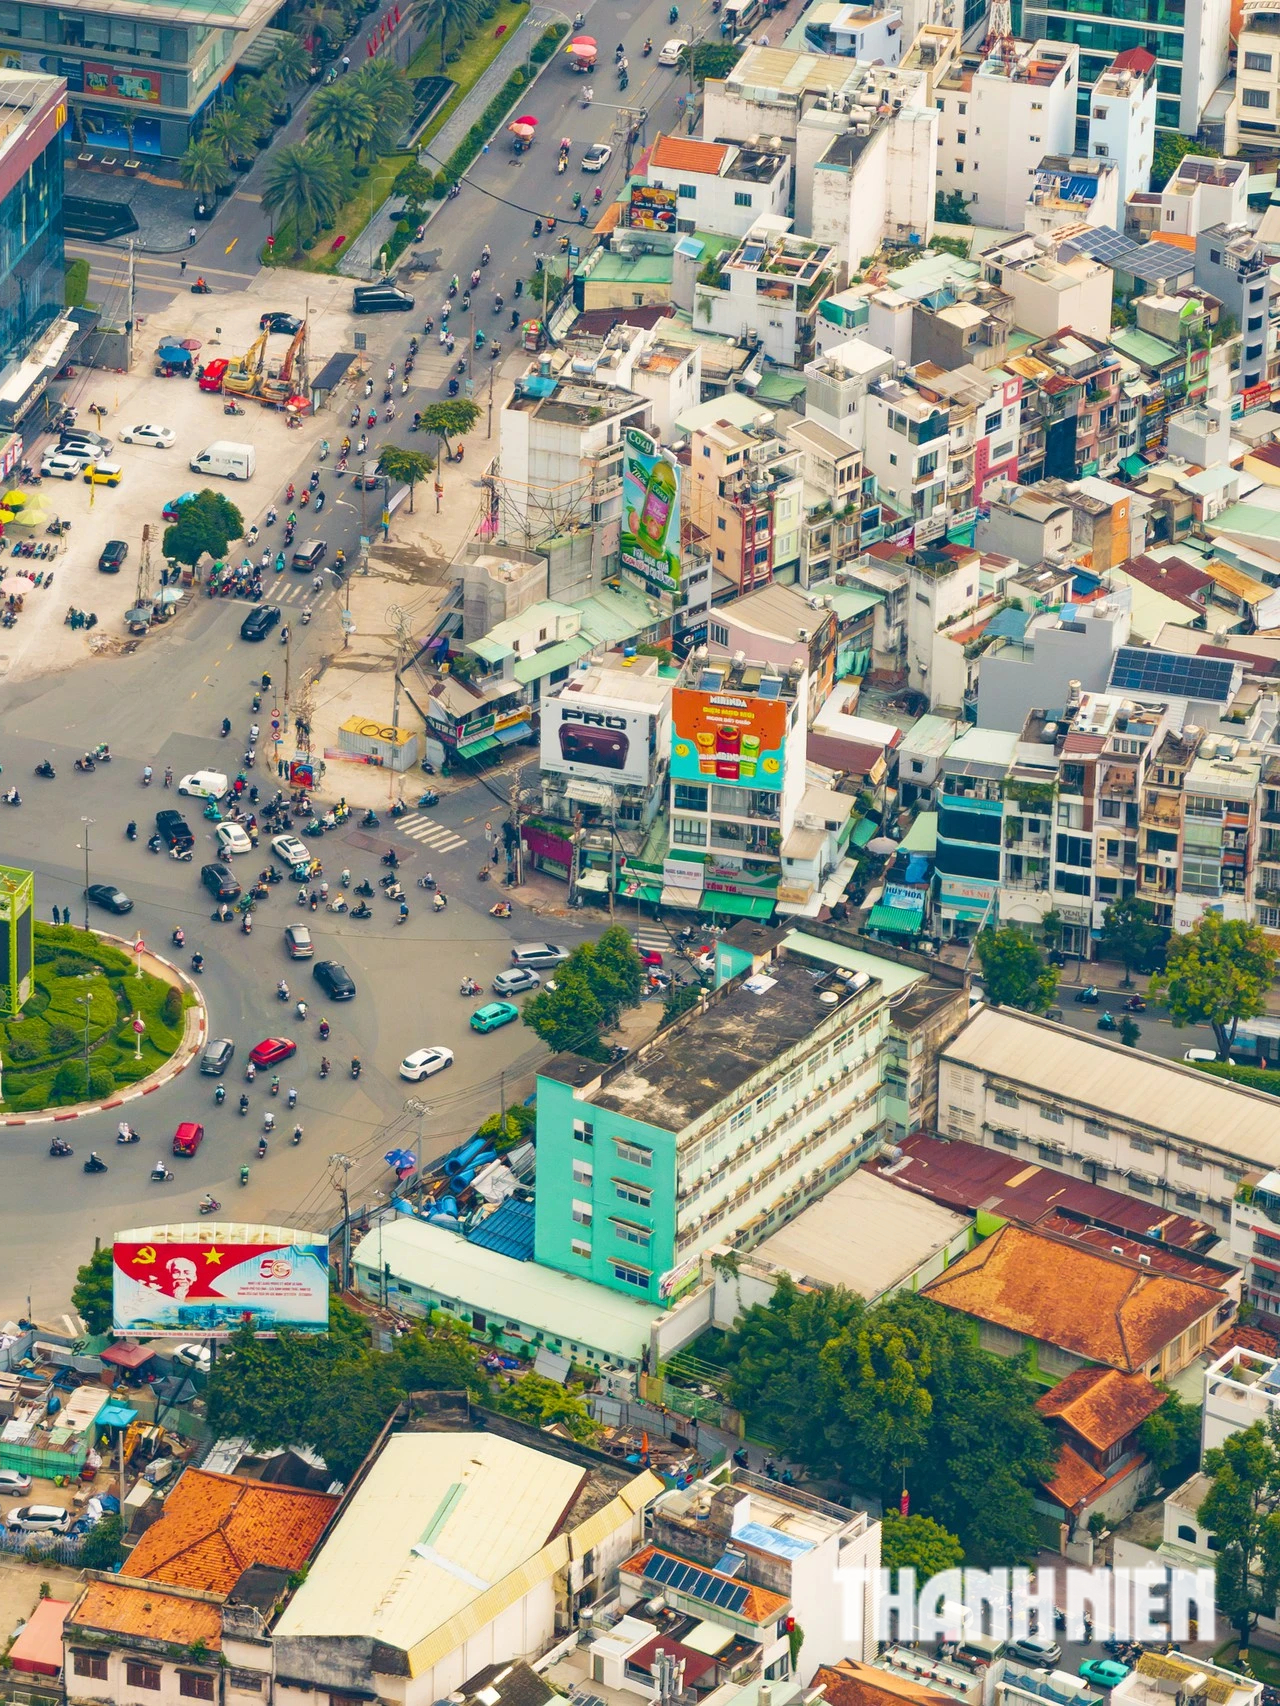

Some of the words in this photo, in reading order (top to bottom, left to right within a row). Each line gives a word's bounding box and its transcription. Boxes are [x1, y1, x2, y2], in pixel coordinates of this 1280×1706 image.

[628, 431, 653, 454] Cozy
[710, 695, 748, 708] MIRINDA
[562, 708, 627, 731] PRO
